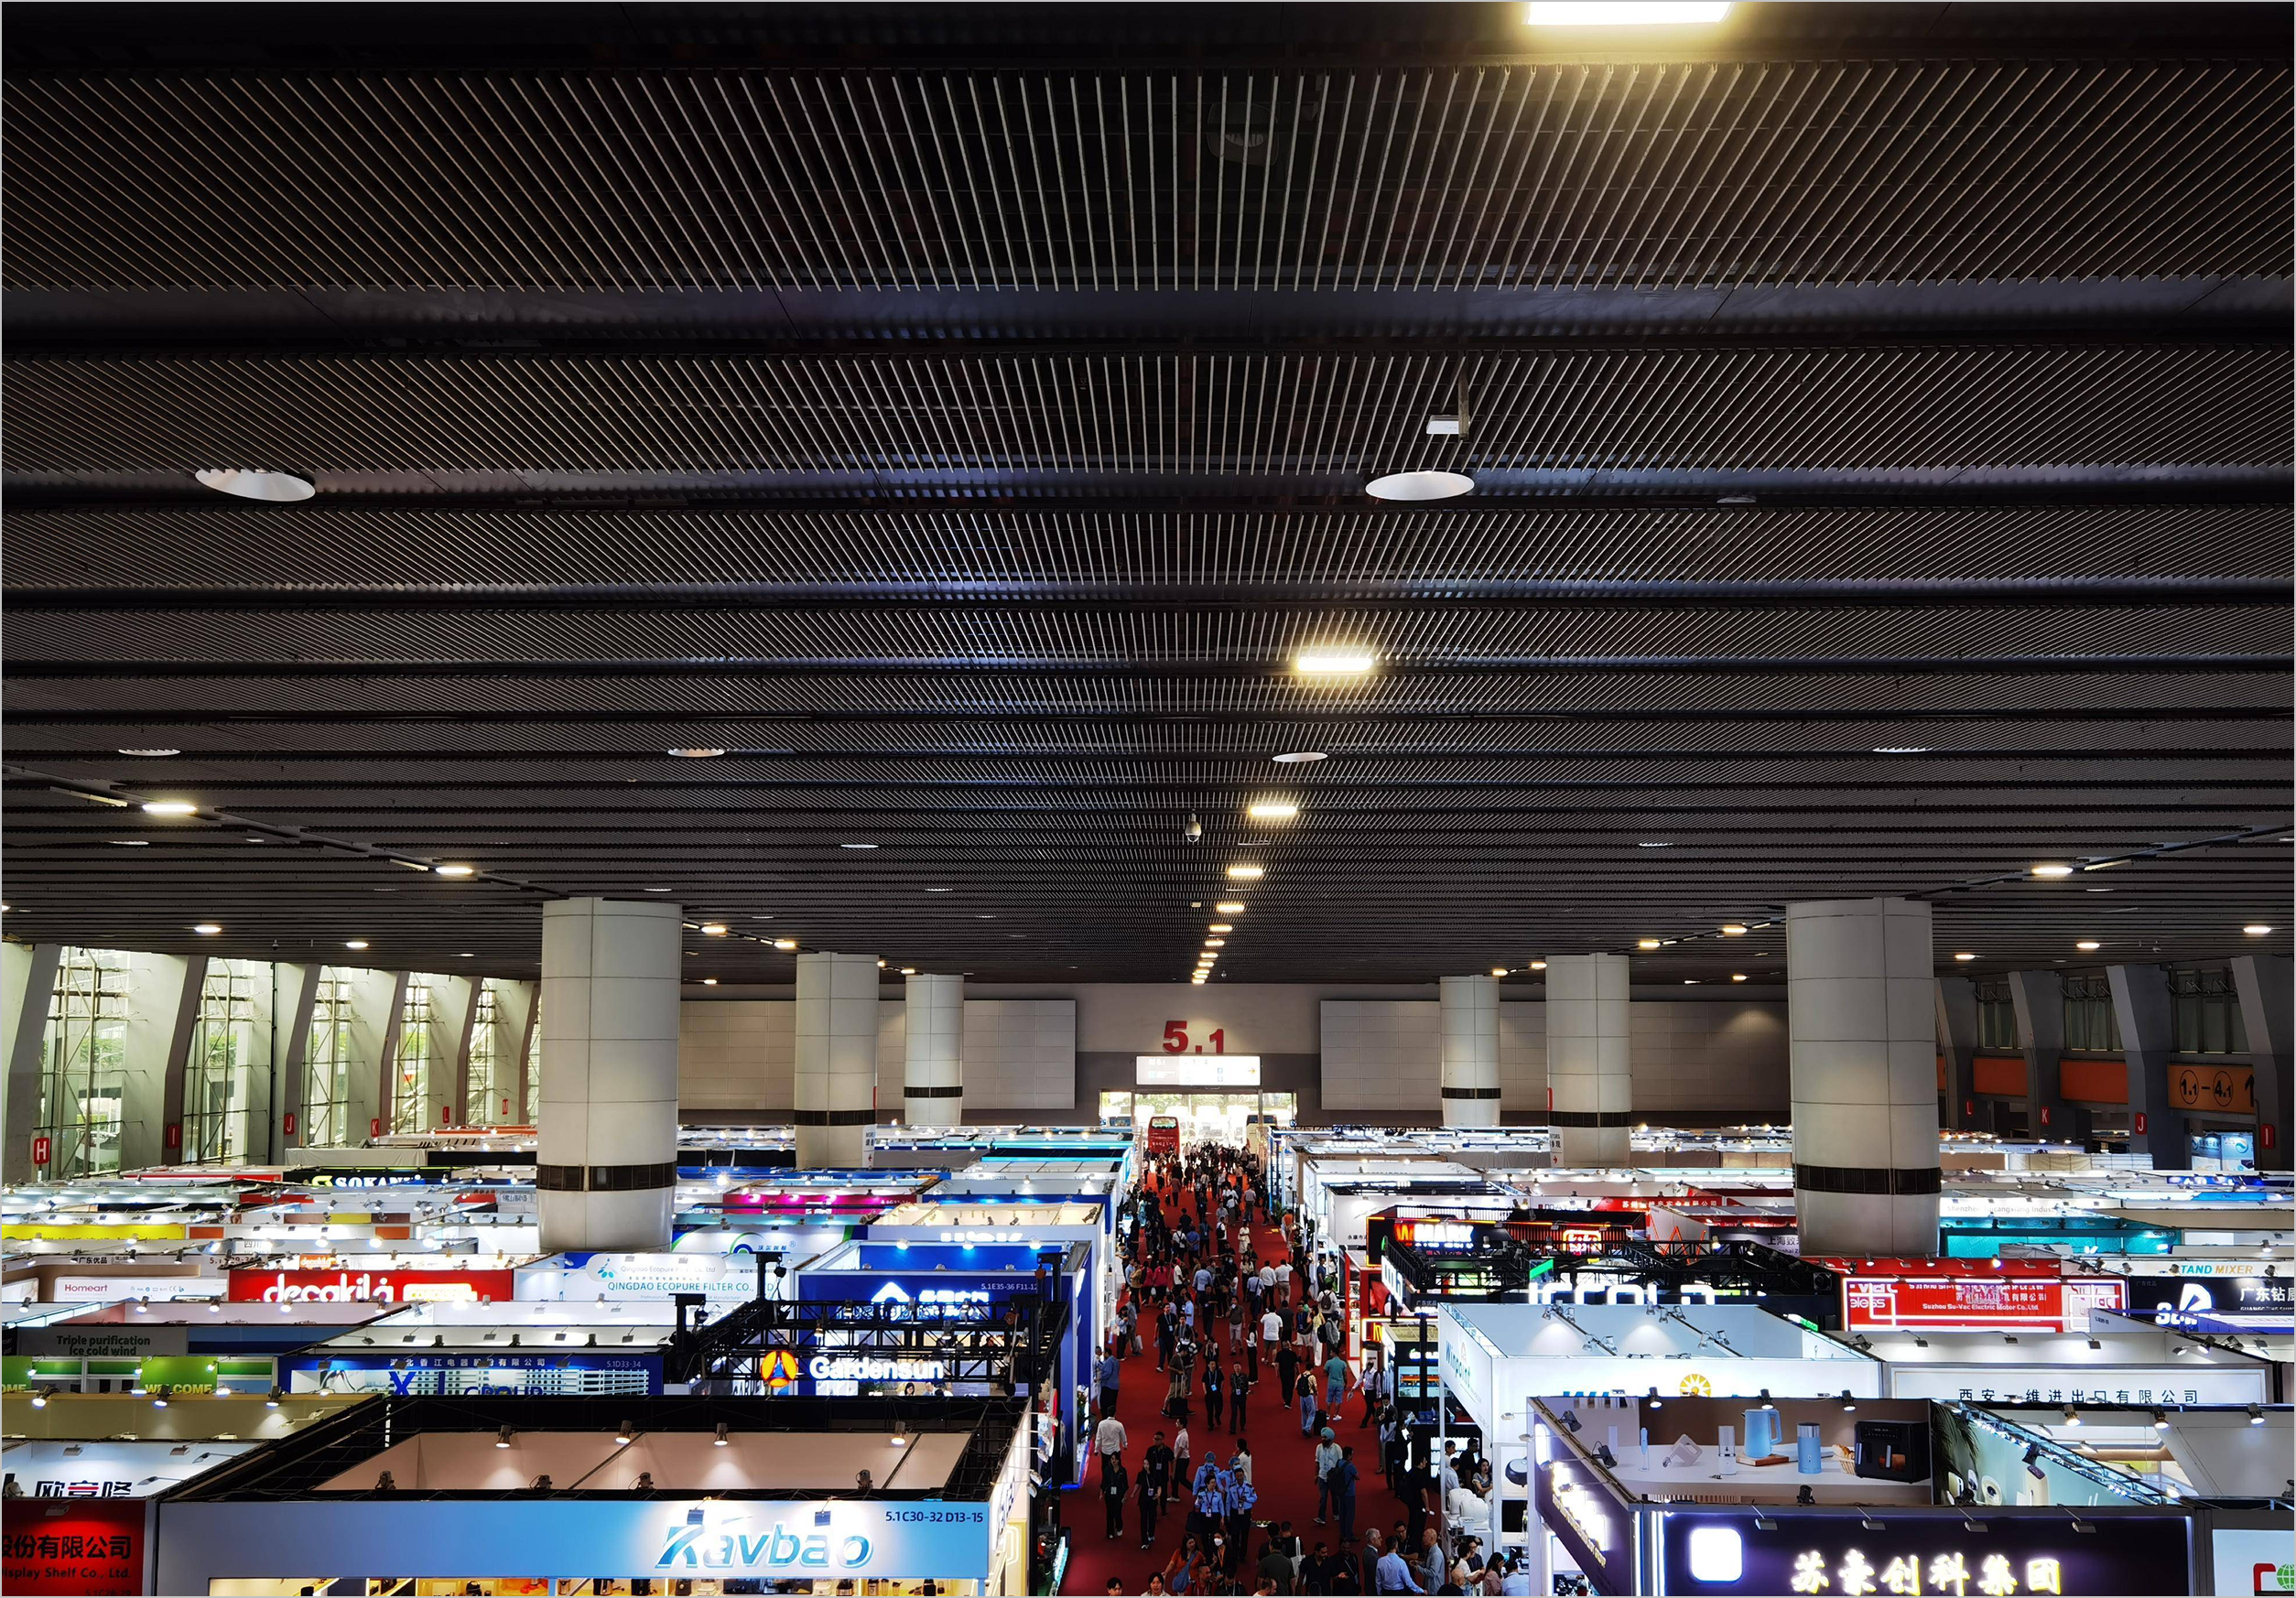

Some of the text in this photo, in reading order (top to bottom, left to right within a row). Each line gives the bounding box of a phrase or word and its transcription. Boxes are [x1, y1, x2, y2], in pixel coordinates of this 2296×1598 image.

[1163, 1020, 1225, 1054] 5.1
[2041, 1109, 2049, 1124] K
[286, 1118, 293, 1132] J
[372, 1120, 379, 1135] K
[2136, 1116, 2145, 1132] J
[37, 1141, 47, 1161] H
[2215, 1265, 2254, 1274] MIXER
[64, 1283, 108, 1292] Homeart
[608, 1281, 655, 1291] QINGDAO
[656, 1281, 700, 1290] ECOPURE
[703, 1282, 733, 1291] FILTER
[56, 1334, 150, 1347] Triple purification
[69, 1346, 136, 1356] Ice cold wind
[809, 1355, 945, 1380] Gardensun
[46, 1567, 77, 1579] Shelf
